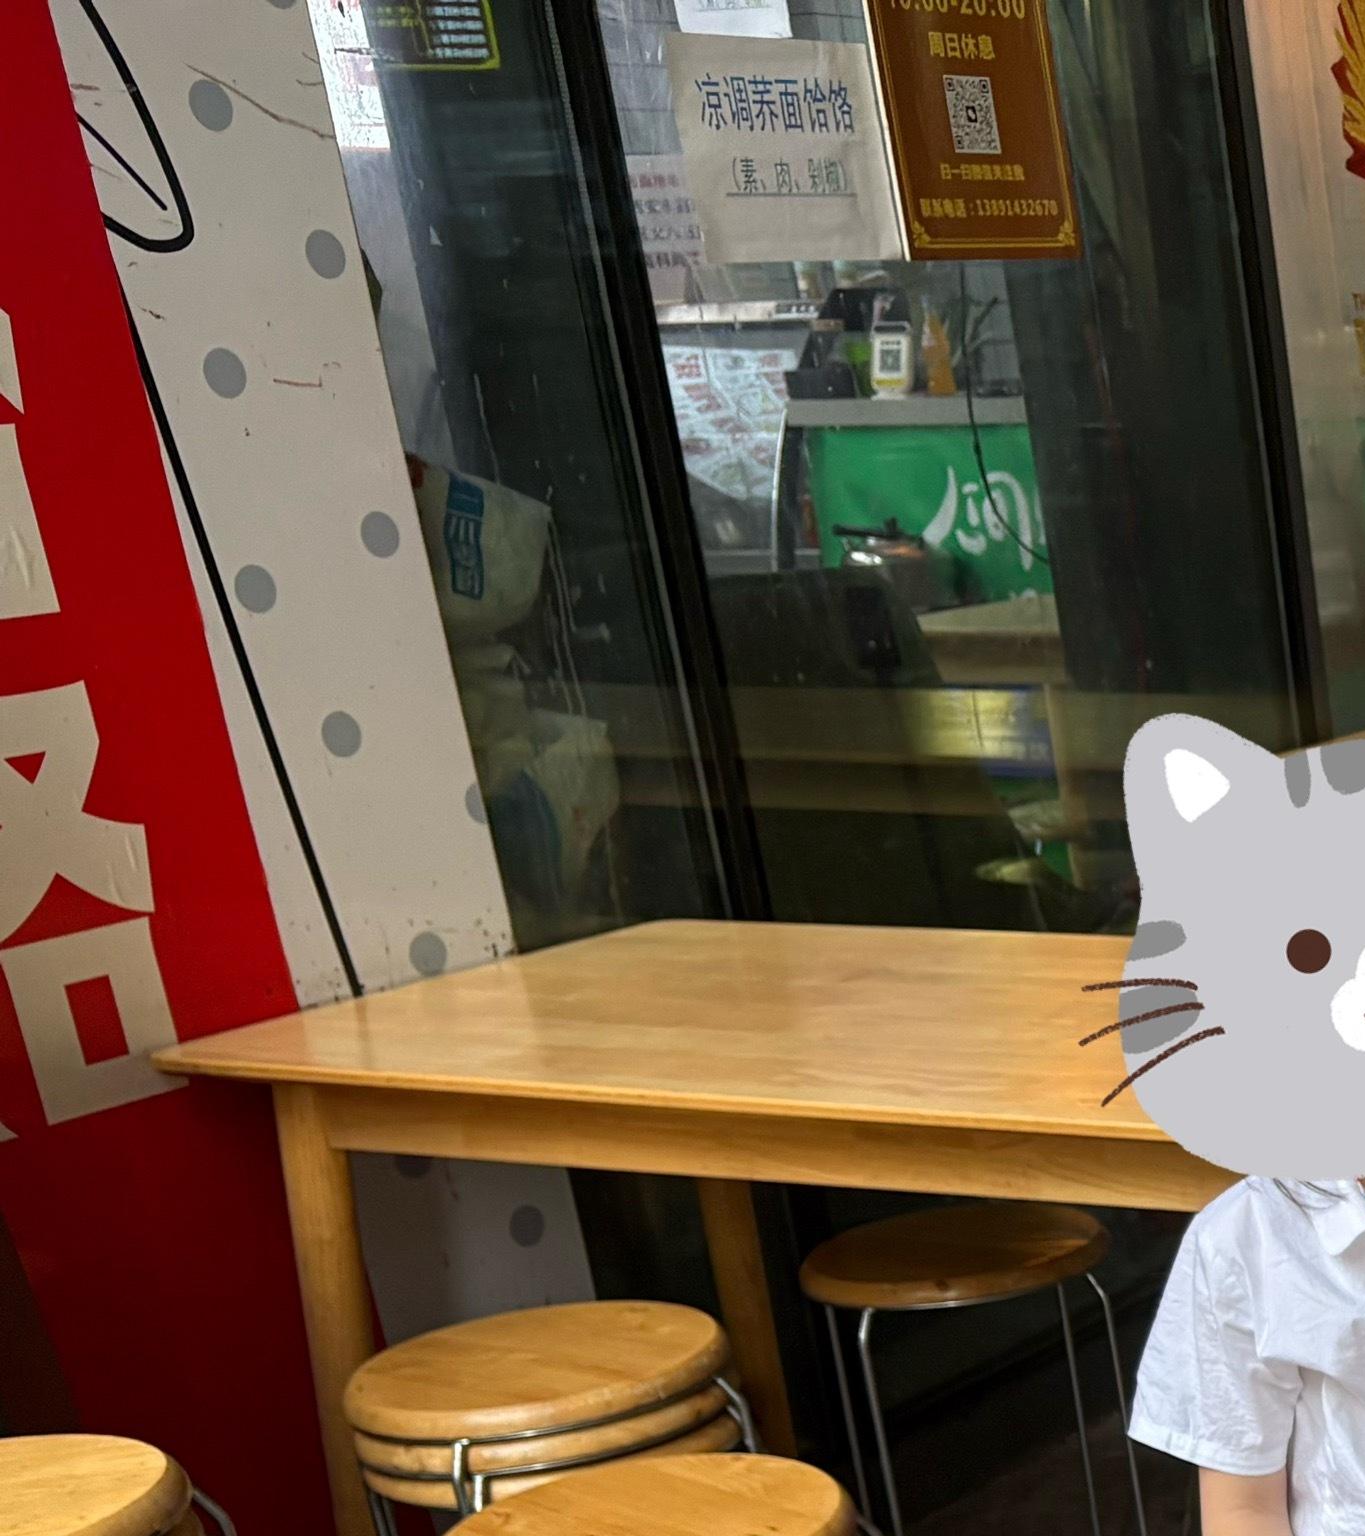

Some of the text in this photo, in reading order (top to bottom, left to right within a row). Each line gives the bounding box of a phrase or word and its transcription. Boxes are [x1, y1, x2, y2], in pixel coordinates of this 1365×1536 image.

[928, 31, 996, 60] 周日休息
[695, 73, 855, 133] 凉调荞面饸饹
